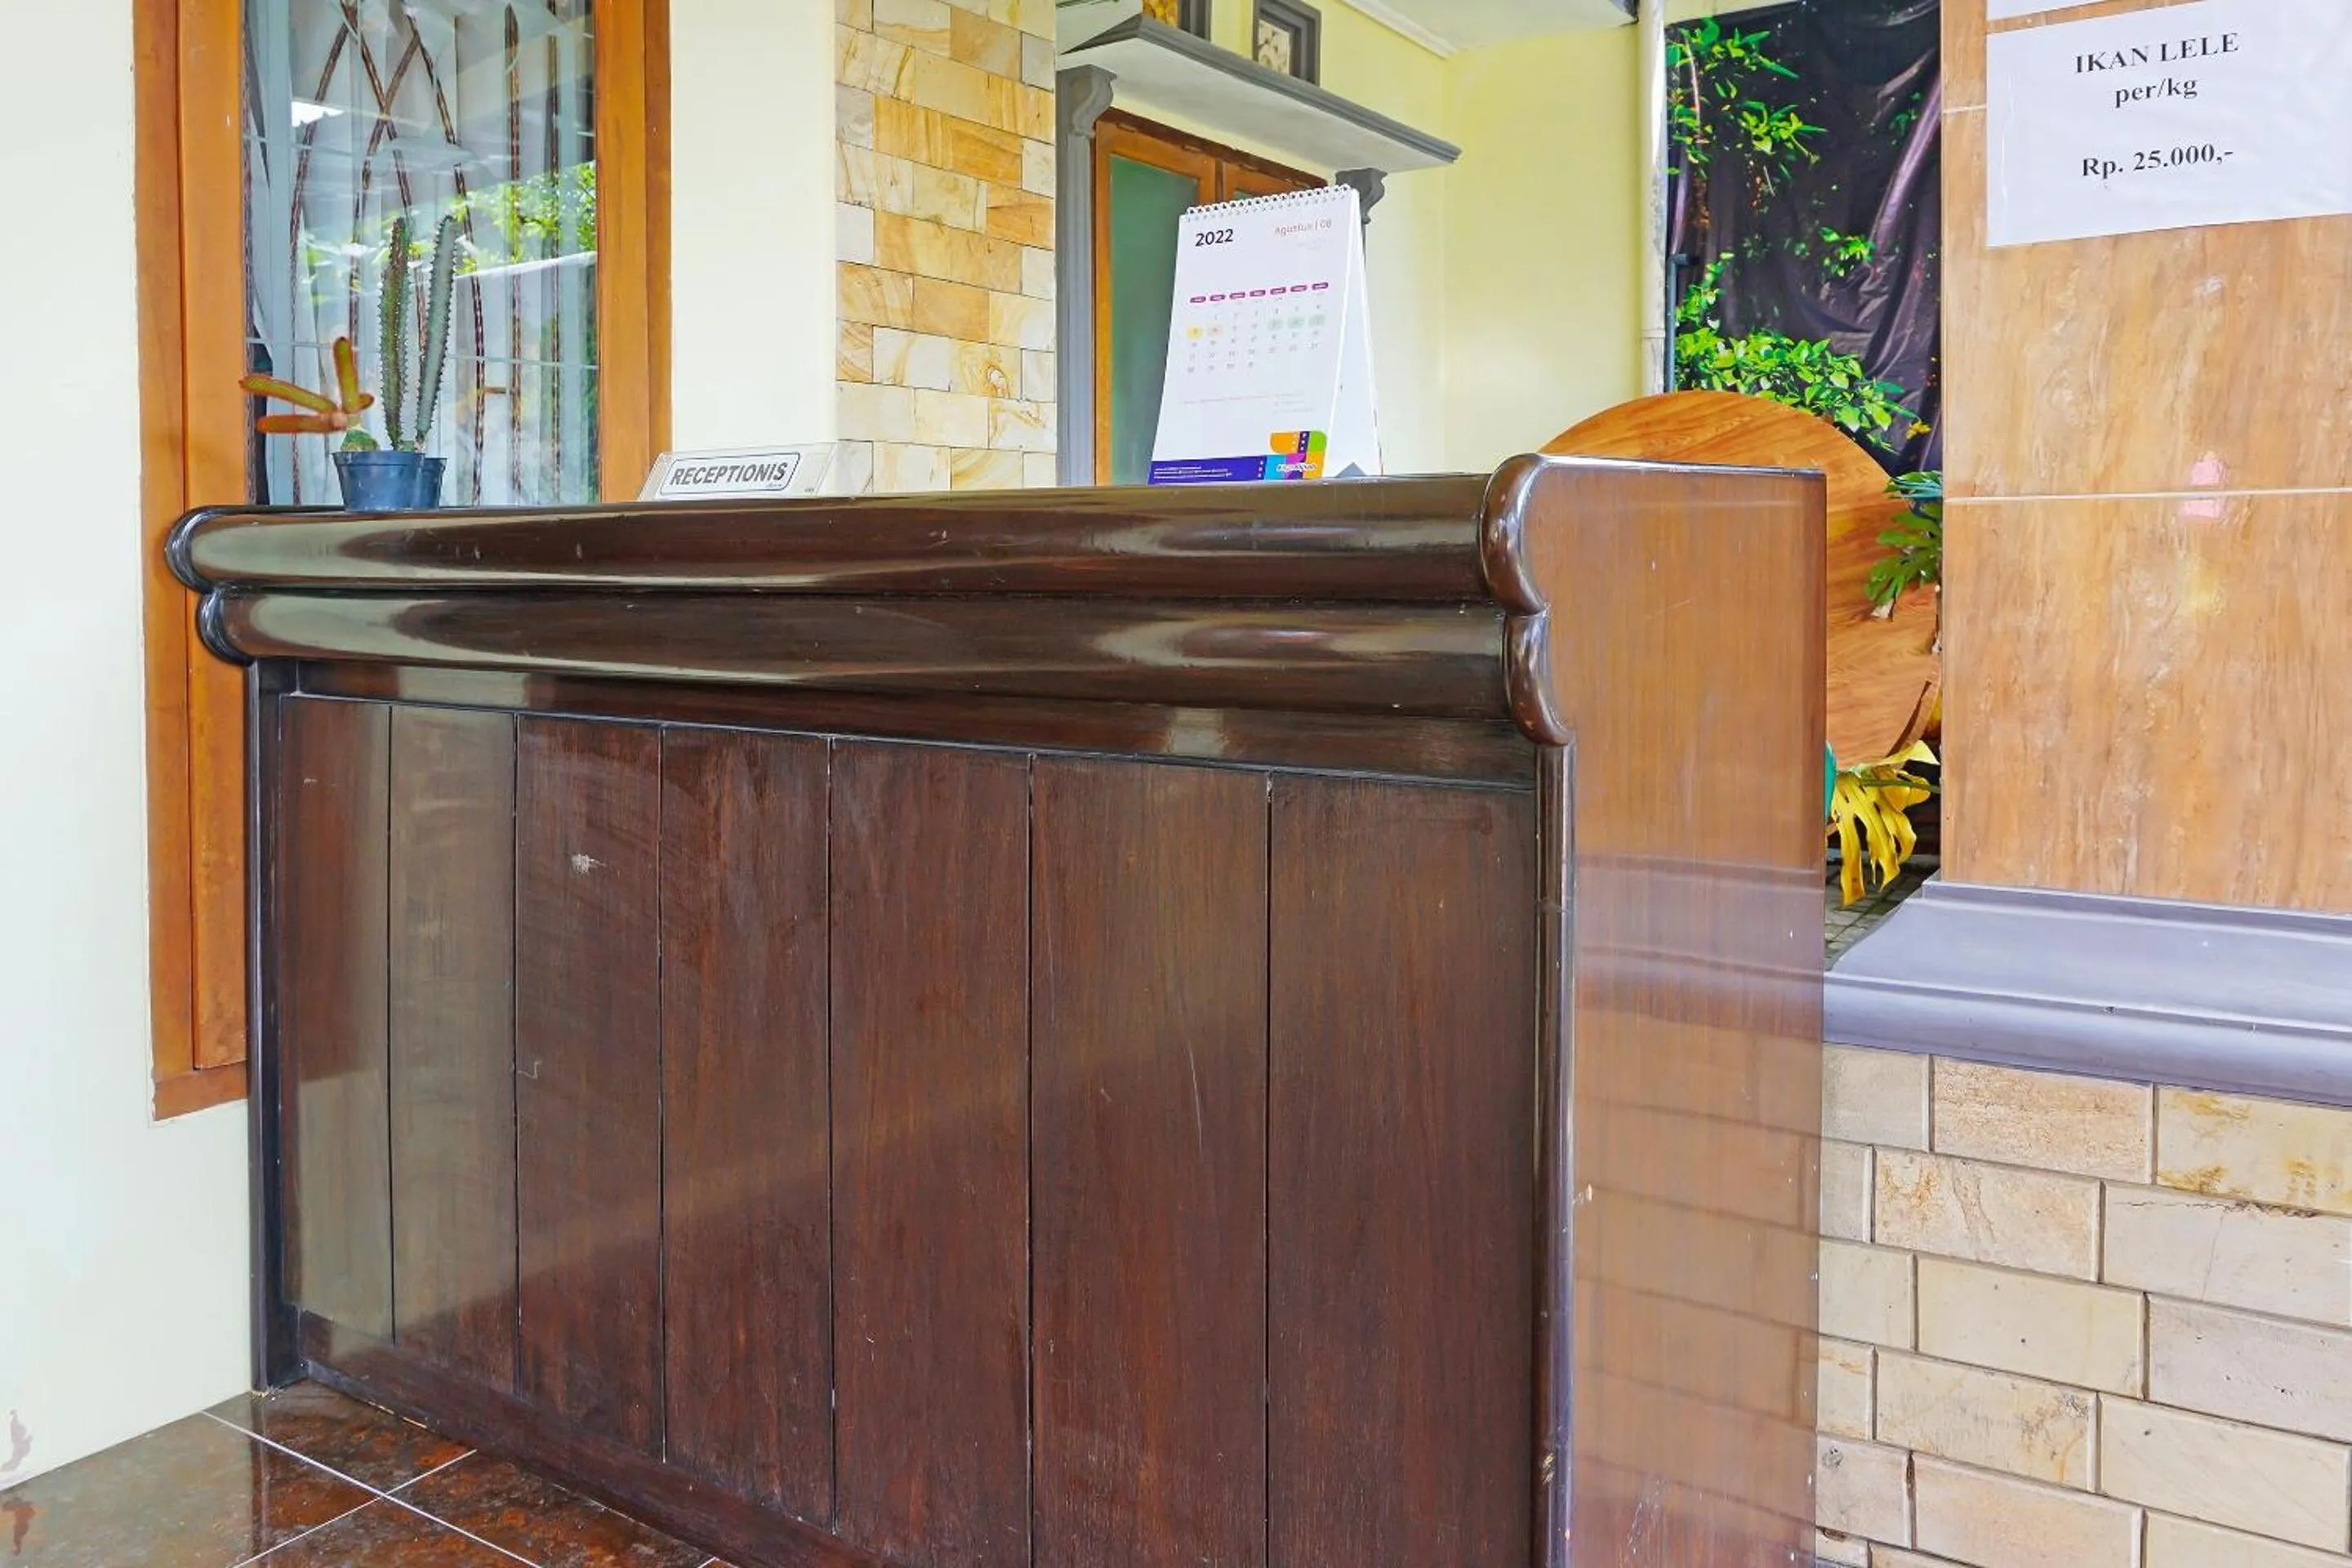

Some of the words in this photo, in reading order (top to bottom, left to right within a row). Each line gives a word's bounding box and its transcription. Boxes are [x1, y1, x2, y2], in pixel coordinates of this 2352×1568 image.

[2074, 45, 2149, 74] IKAN
[2160, 32, 2240, 62] LELE
[2115, 78, 2198, 109] per/kg
[2082, 156, 2124, 180] Rp.
[2133, 142, 2234, 172] 25.000,-
[1195, 228, 1234, 247] 2022
[670, 461, 788, 485] RECEPTIONIS
